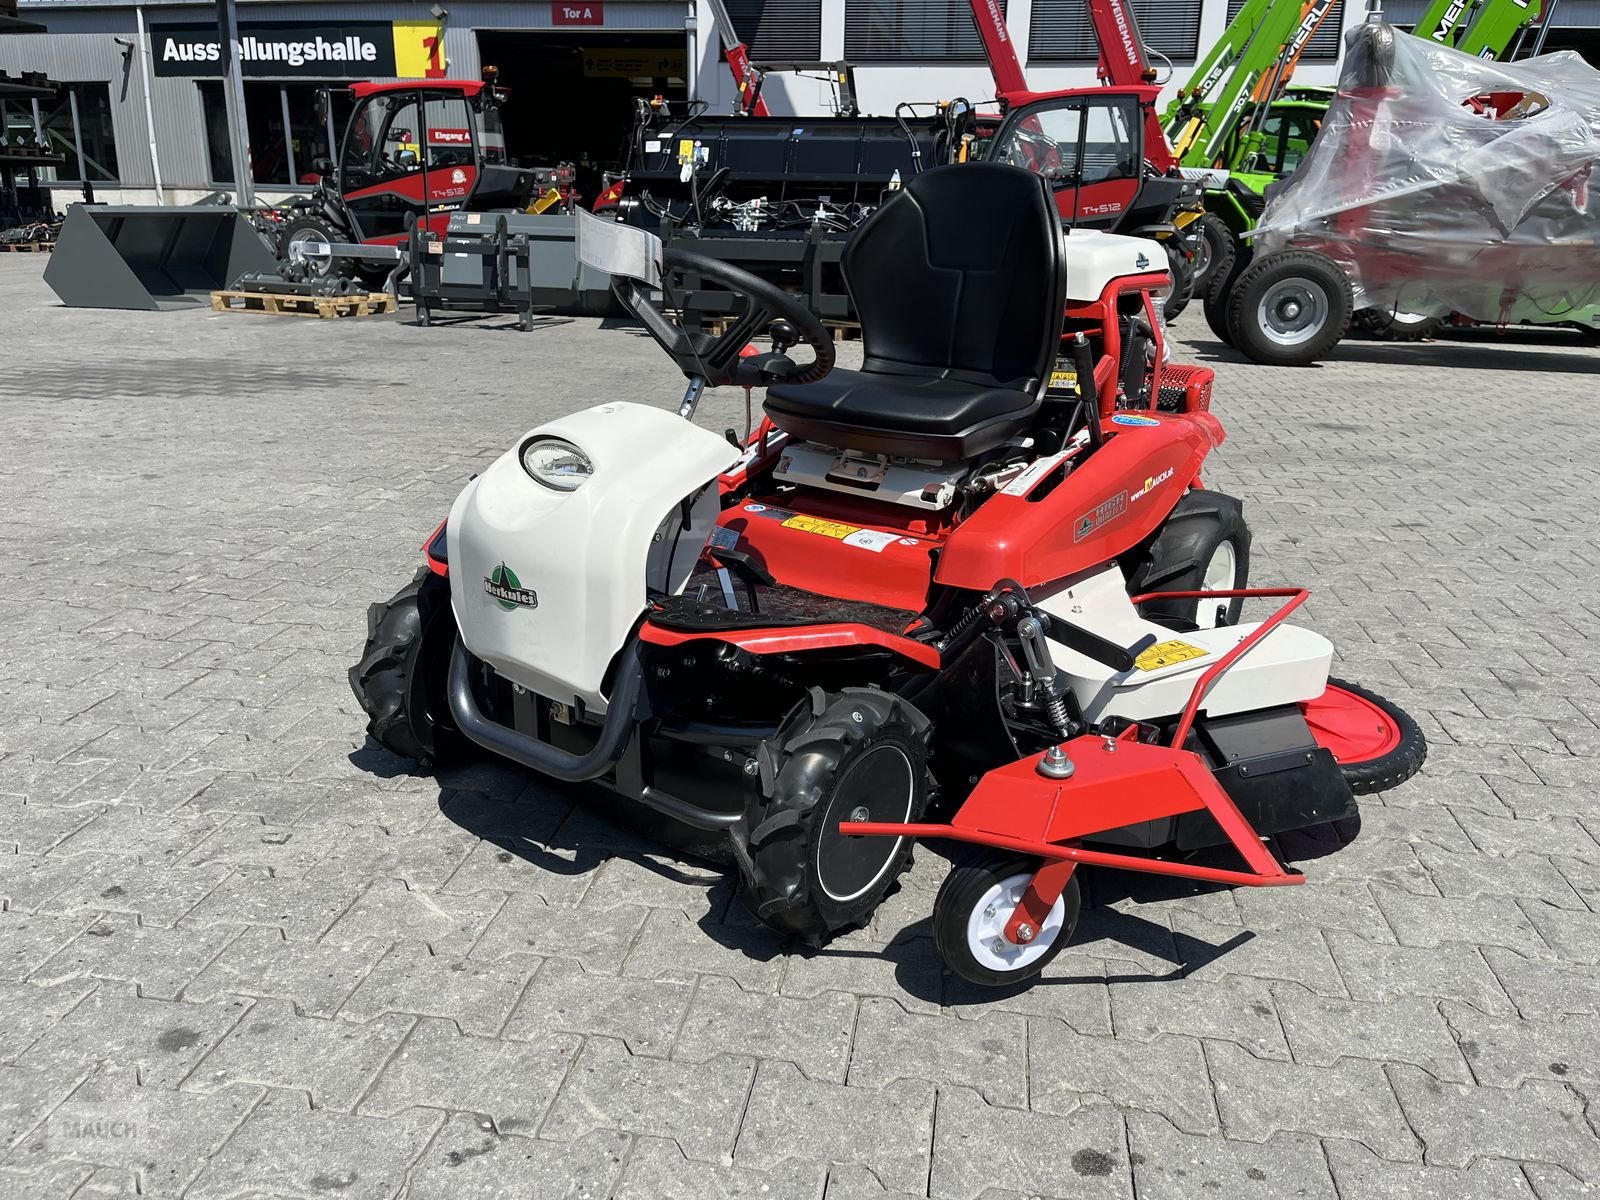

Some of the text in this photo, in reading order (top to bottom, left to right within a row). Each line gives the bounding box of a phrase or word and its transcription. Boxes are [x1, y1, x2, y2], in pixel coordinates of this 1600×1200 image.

[563, 8, 592, 18] Tor A
[986, 0, 1008, 43] IDEMANN
[1280, 0, 1333, 62] MERL
[163, 36, 447, 79] Aussellungshalle 1
[1233, 89, 1249, 113] 30.7
[435, 132, 471, 141] Eingang A
[432, 187, 465, 198] T4512
[1082, 202, 1121, 214] T4512
[1130, 467, 1174, 502] www.MAUCH.at
[484, 580, 536, 605] Herkules
